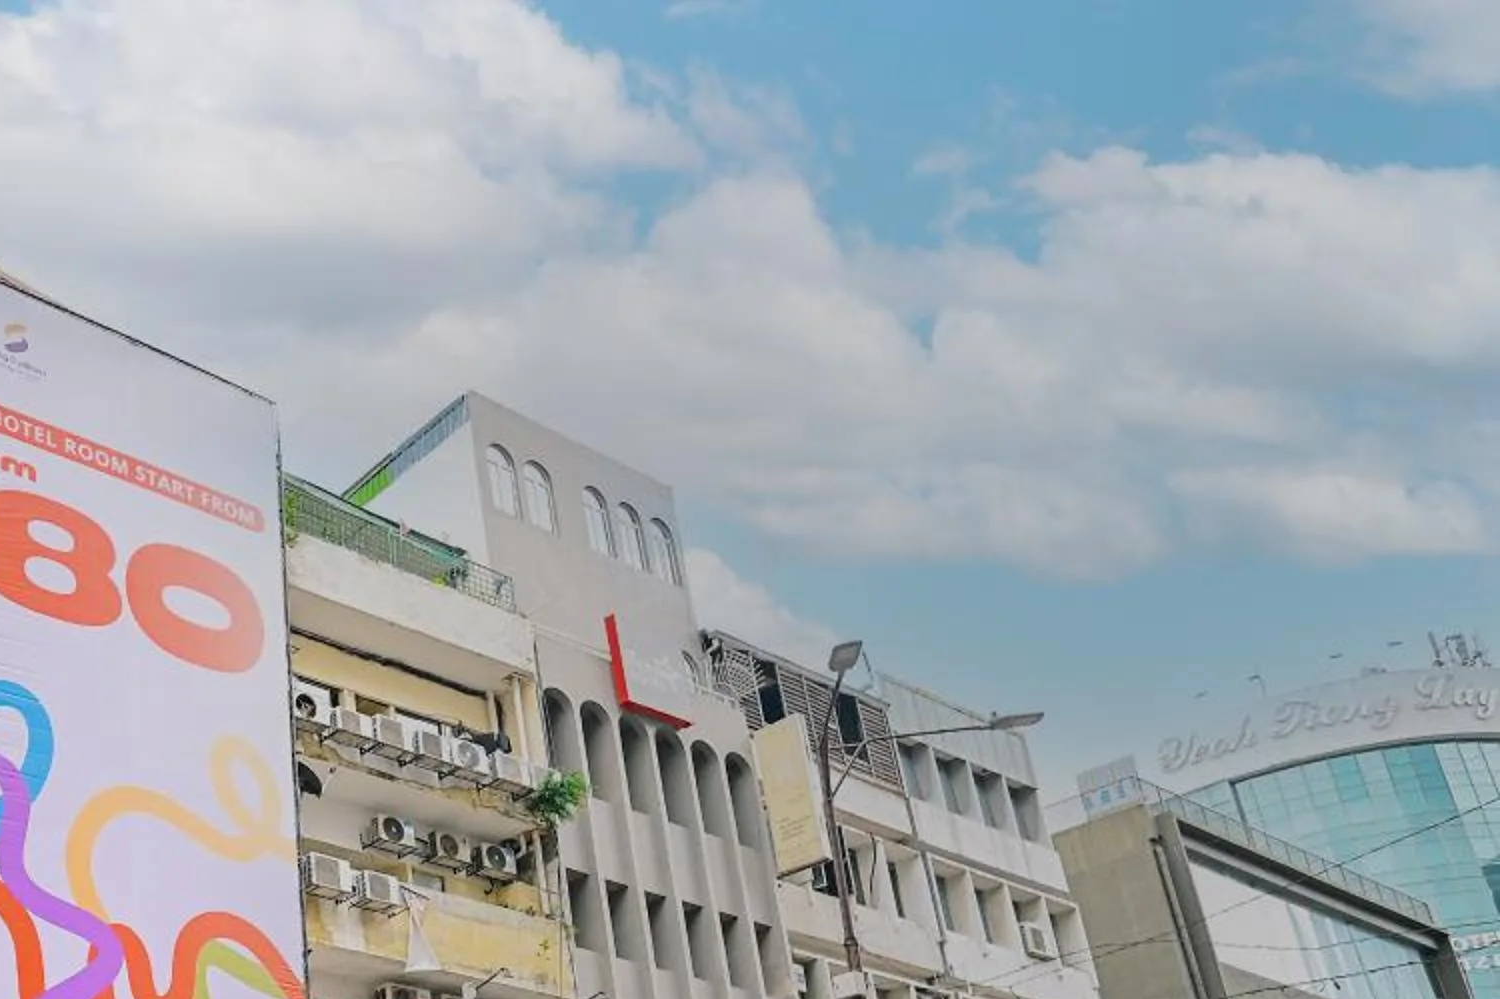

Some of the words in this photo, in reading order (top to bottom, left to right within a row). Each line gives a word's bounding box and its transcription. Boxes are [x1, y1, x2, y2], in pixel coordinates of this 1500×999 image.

[64, 436, 128, 476] ROOM
[134, 463, 195, 503] START
[201, 489, 257, 527] FROM
